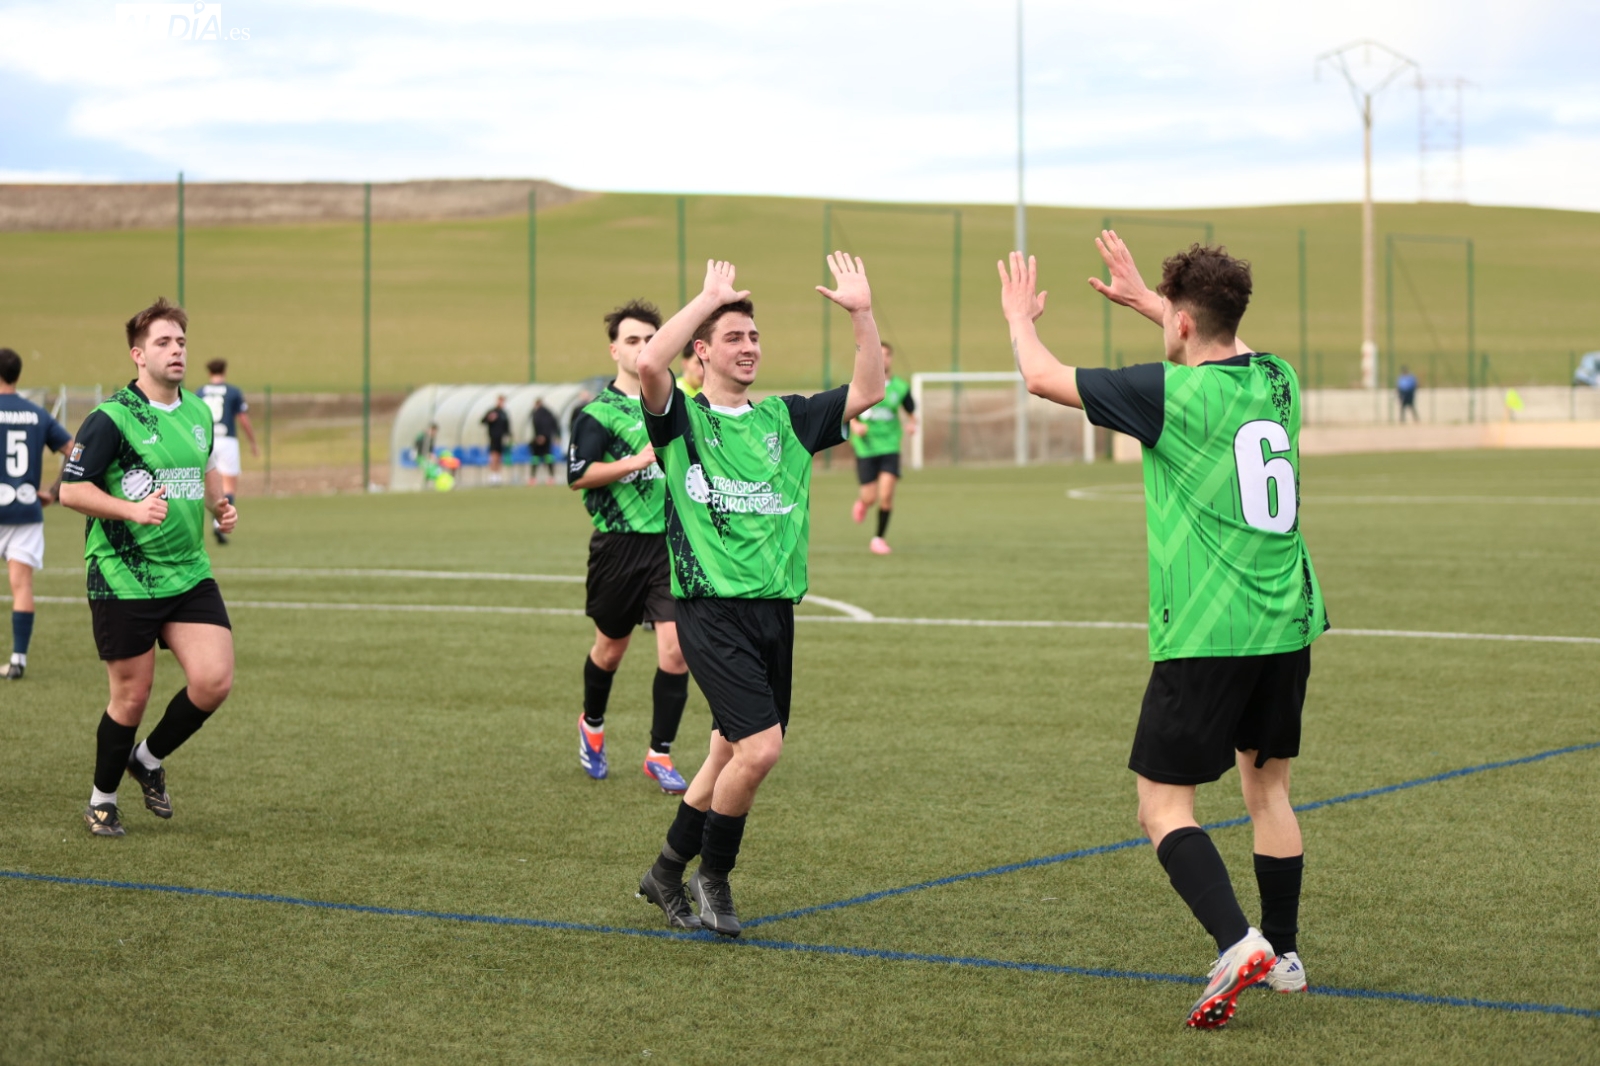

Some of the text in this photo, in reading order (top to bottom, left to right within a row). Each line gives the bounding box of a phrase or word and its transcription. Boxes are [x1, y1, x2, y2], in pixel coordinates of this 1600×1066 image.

[5, 430, 29, 478] 5
[154, 467, 201, 480] TRANSPORTES
[1233, 419, 1297, 534] 6
